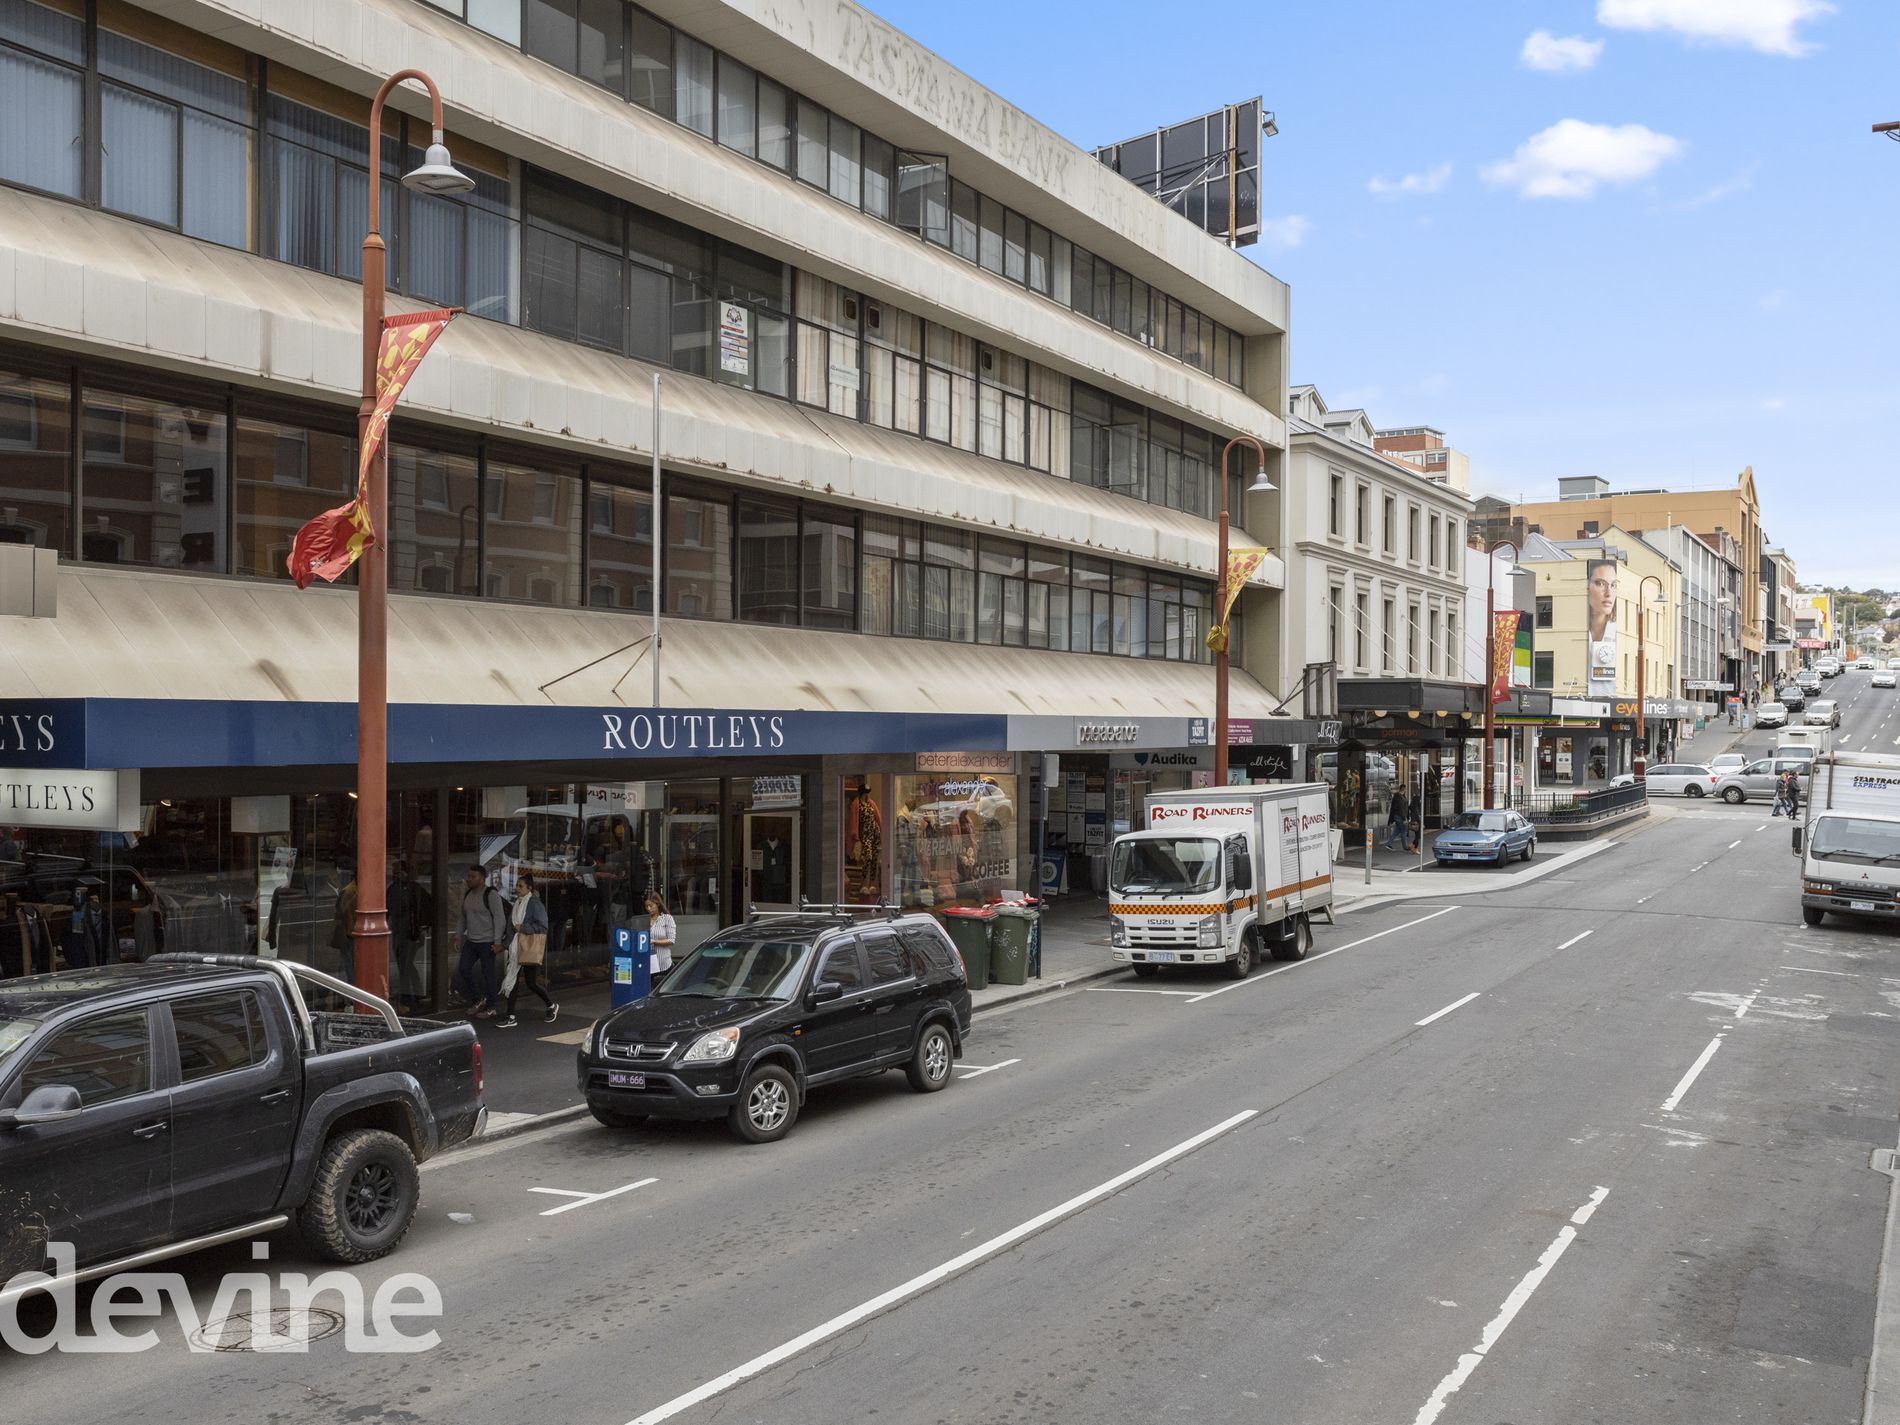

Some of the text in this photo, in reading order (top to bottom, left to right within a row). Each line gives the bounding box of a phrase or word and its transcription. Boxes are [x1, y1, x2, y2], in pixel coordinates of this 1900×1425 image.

[0, 714, 55, 752] YS
[603, 714, 784, 750] ROUTLEYS
[918, 752, 1012, 769] peteralexander
[1151, 753, 1197, 765] Audika
[1853, 775, 1875, 783] STAR
[0, 784, 95, 812] TLEYS
[1152, 806, 1253, 821] ROAD RUNNERS
[1301, 813, 1326, 831] RUNNERS
[972, 859, 1010, 880] COFFEE
[619, 931, 647, 950] P P
